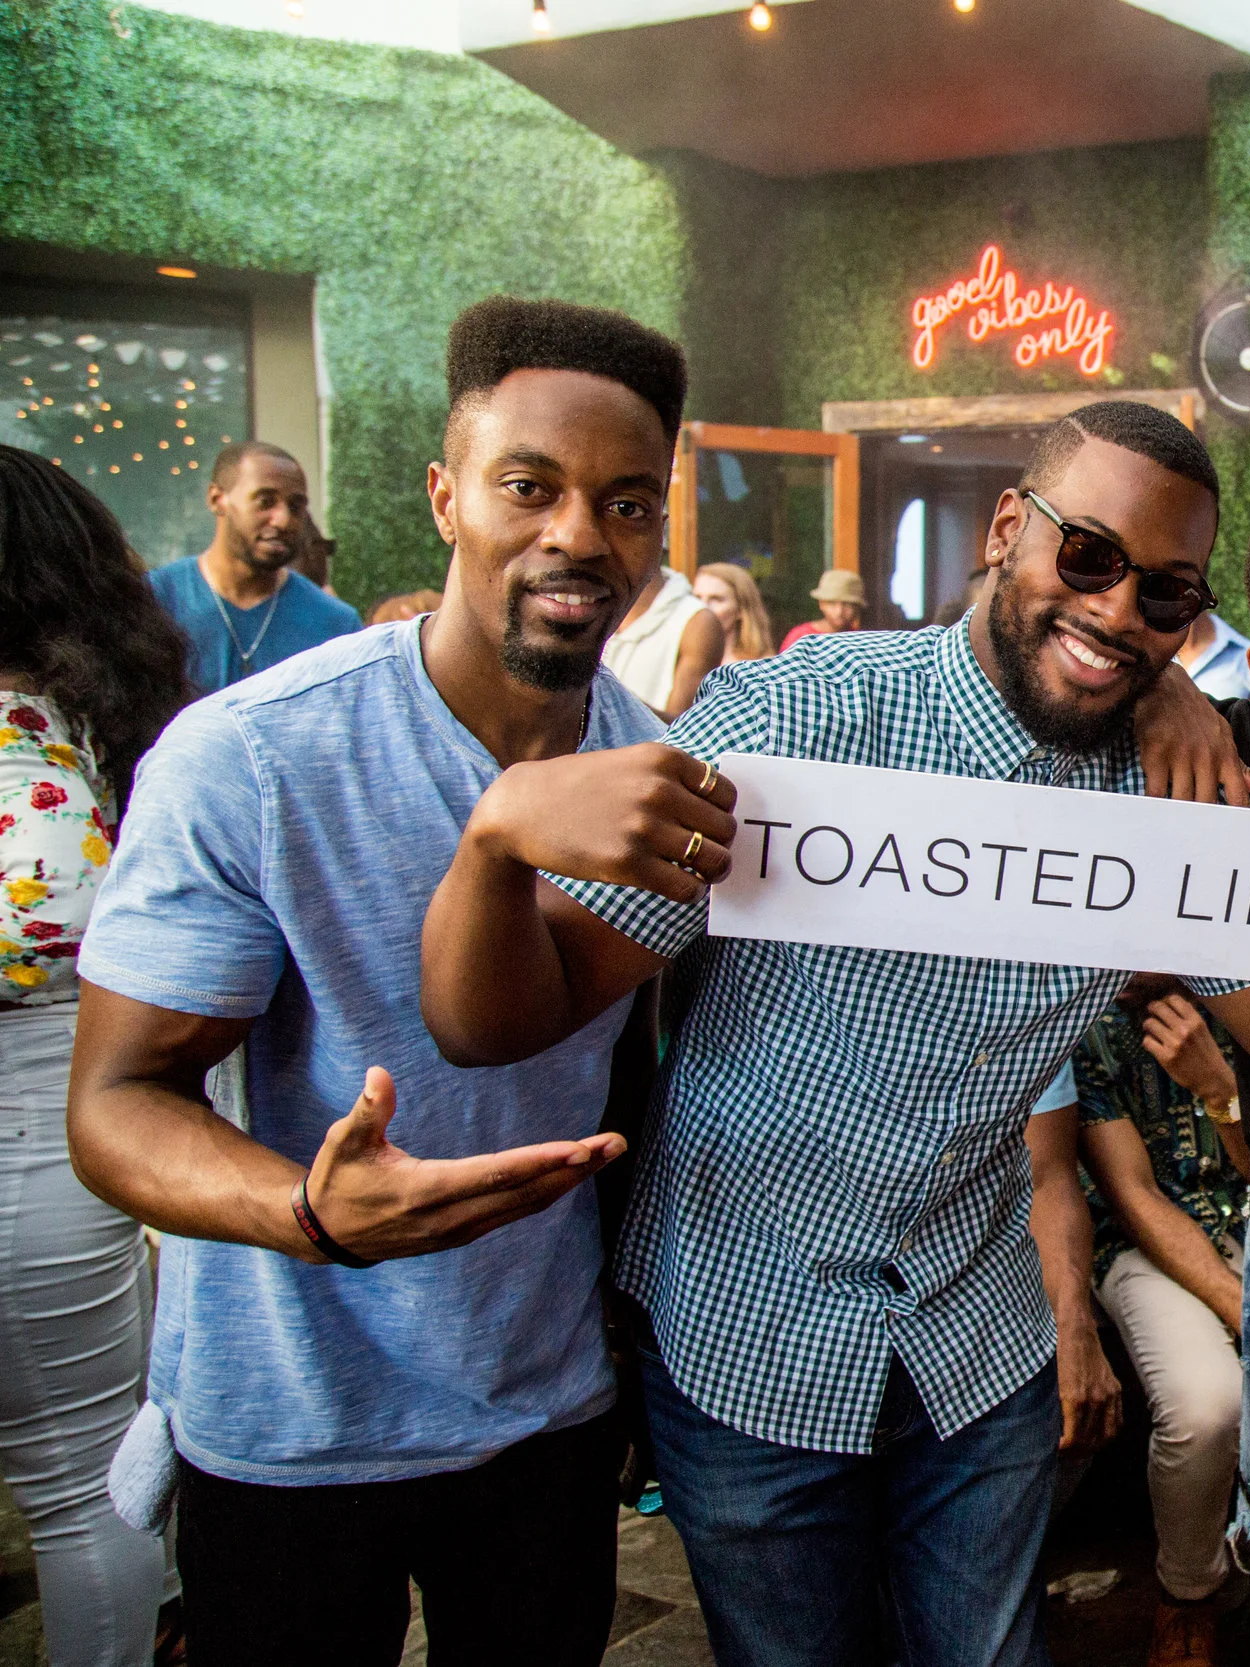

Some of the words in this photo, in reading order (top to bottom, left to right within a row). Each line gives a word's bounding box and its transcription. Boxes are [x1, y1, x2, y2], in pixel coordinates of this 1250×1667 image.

[913, 245, 1003, 368] good
[968, 271, 1074, 341] vibes
[1015, 296, 1113, 375] only
[743, 818, 1136, 912] TOASTED
